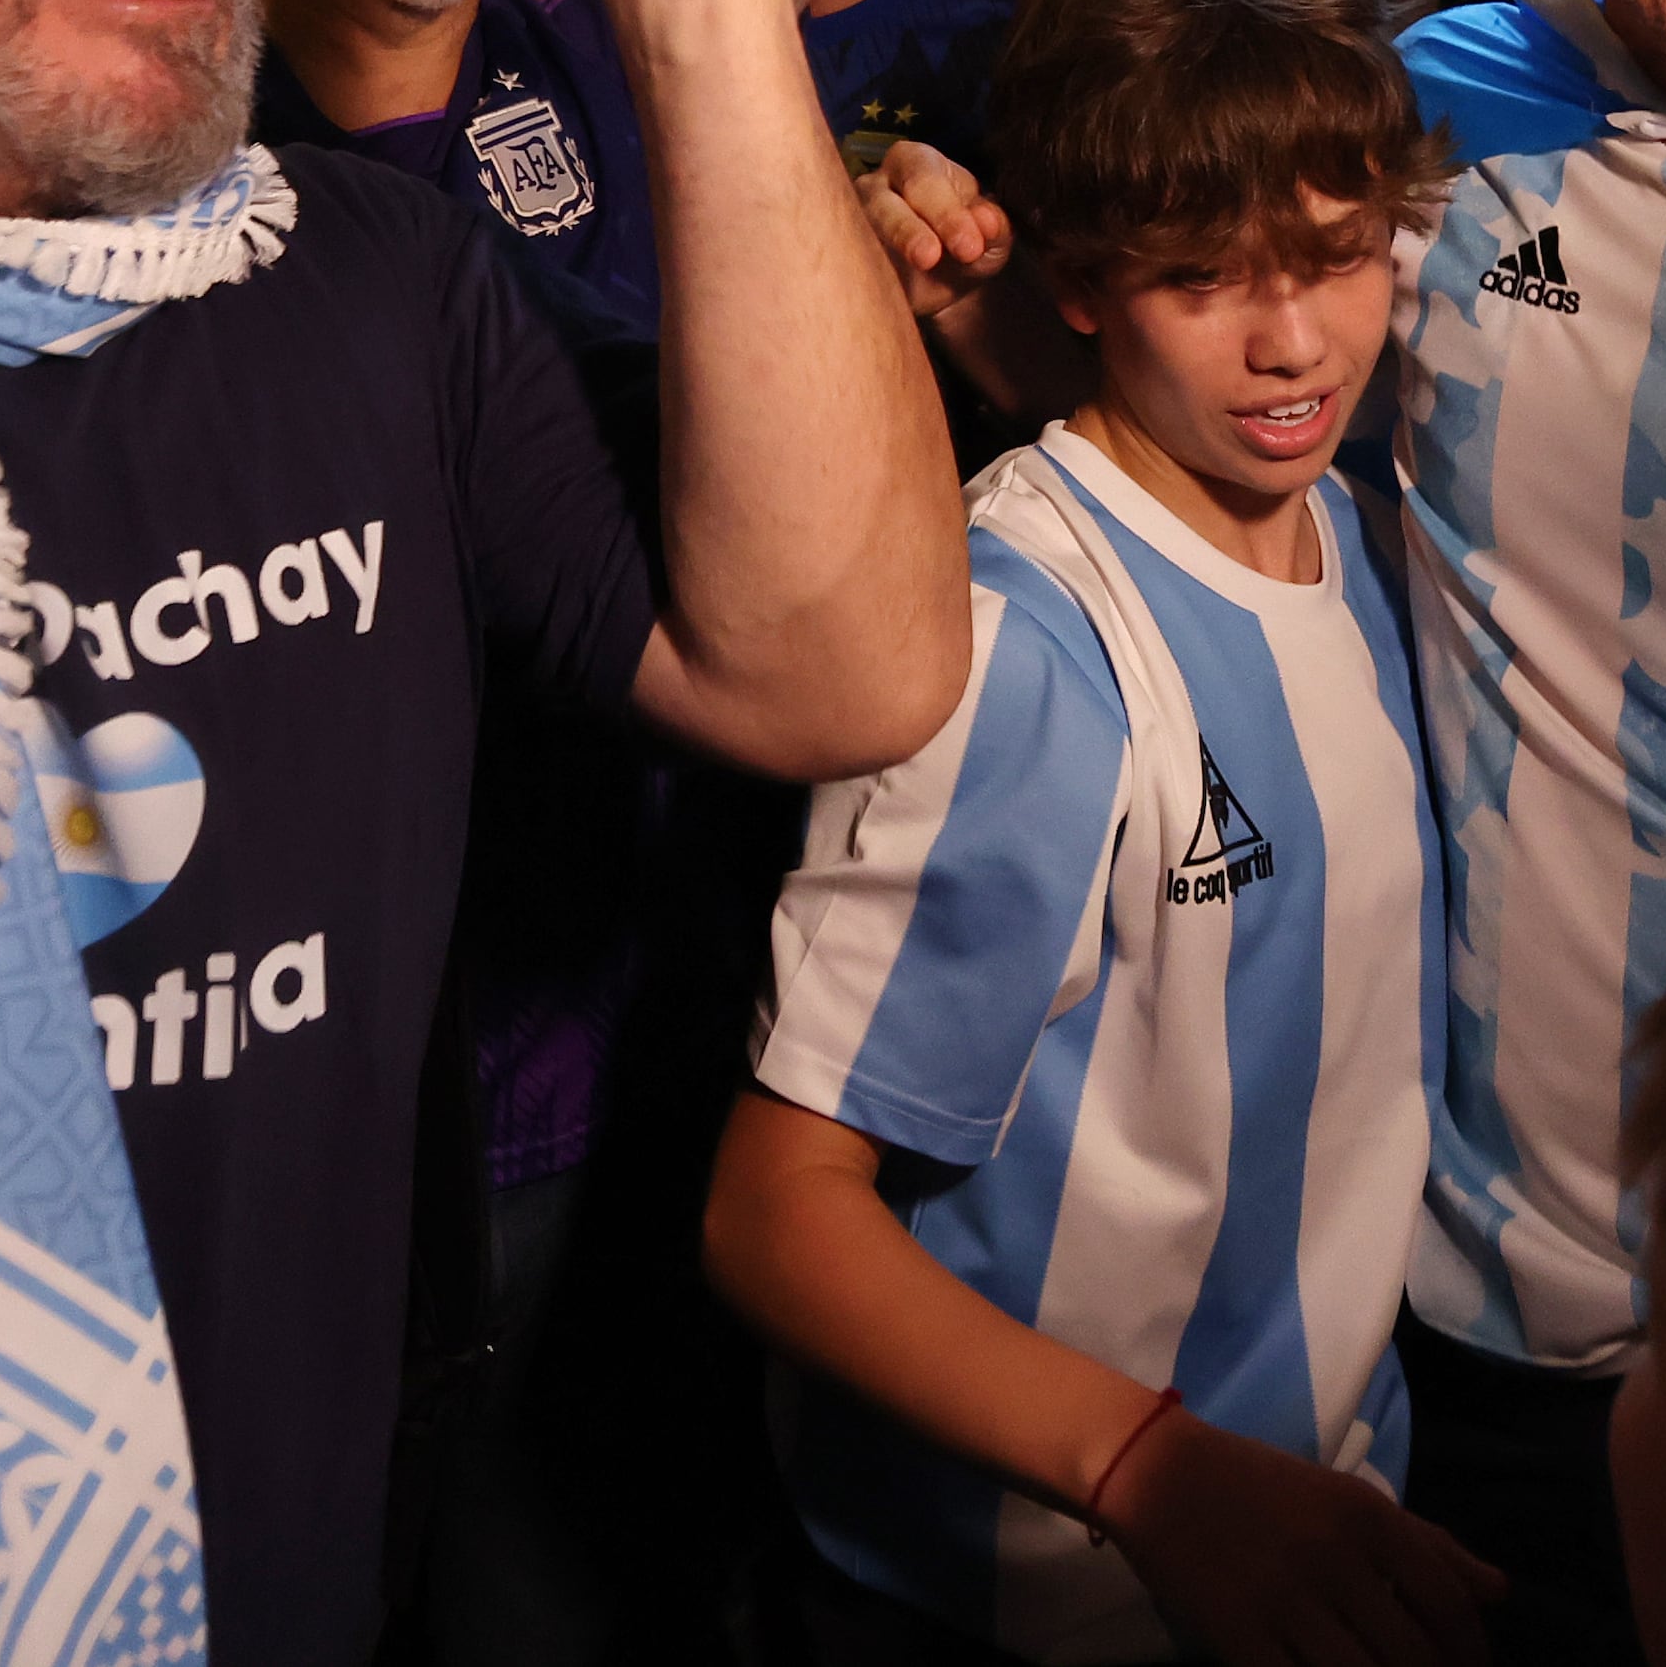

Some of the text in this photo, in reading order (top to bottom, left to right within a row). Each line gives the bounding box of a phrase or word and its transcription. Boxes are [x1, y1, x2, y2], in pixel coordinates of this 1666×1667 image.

[506, 136, 566, 192] AFA
[1479, 270, 1581, 314] adidas
[1166, 868, 1189, 905] le
[1194, 869, 1226, 905] coq
